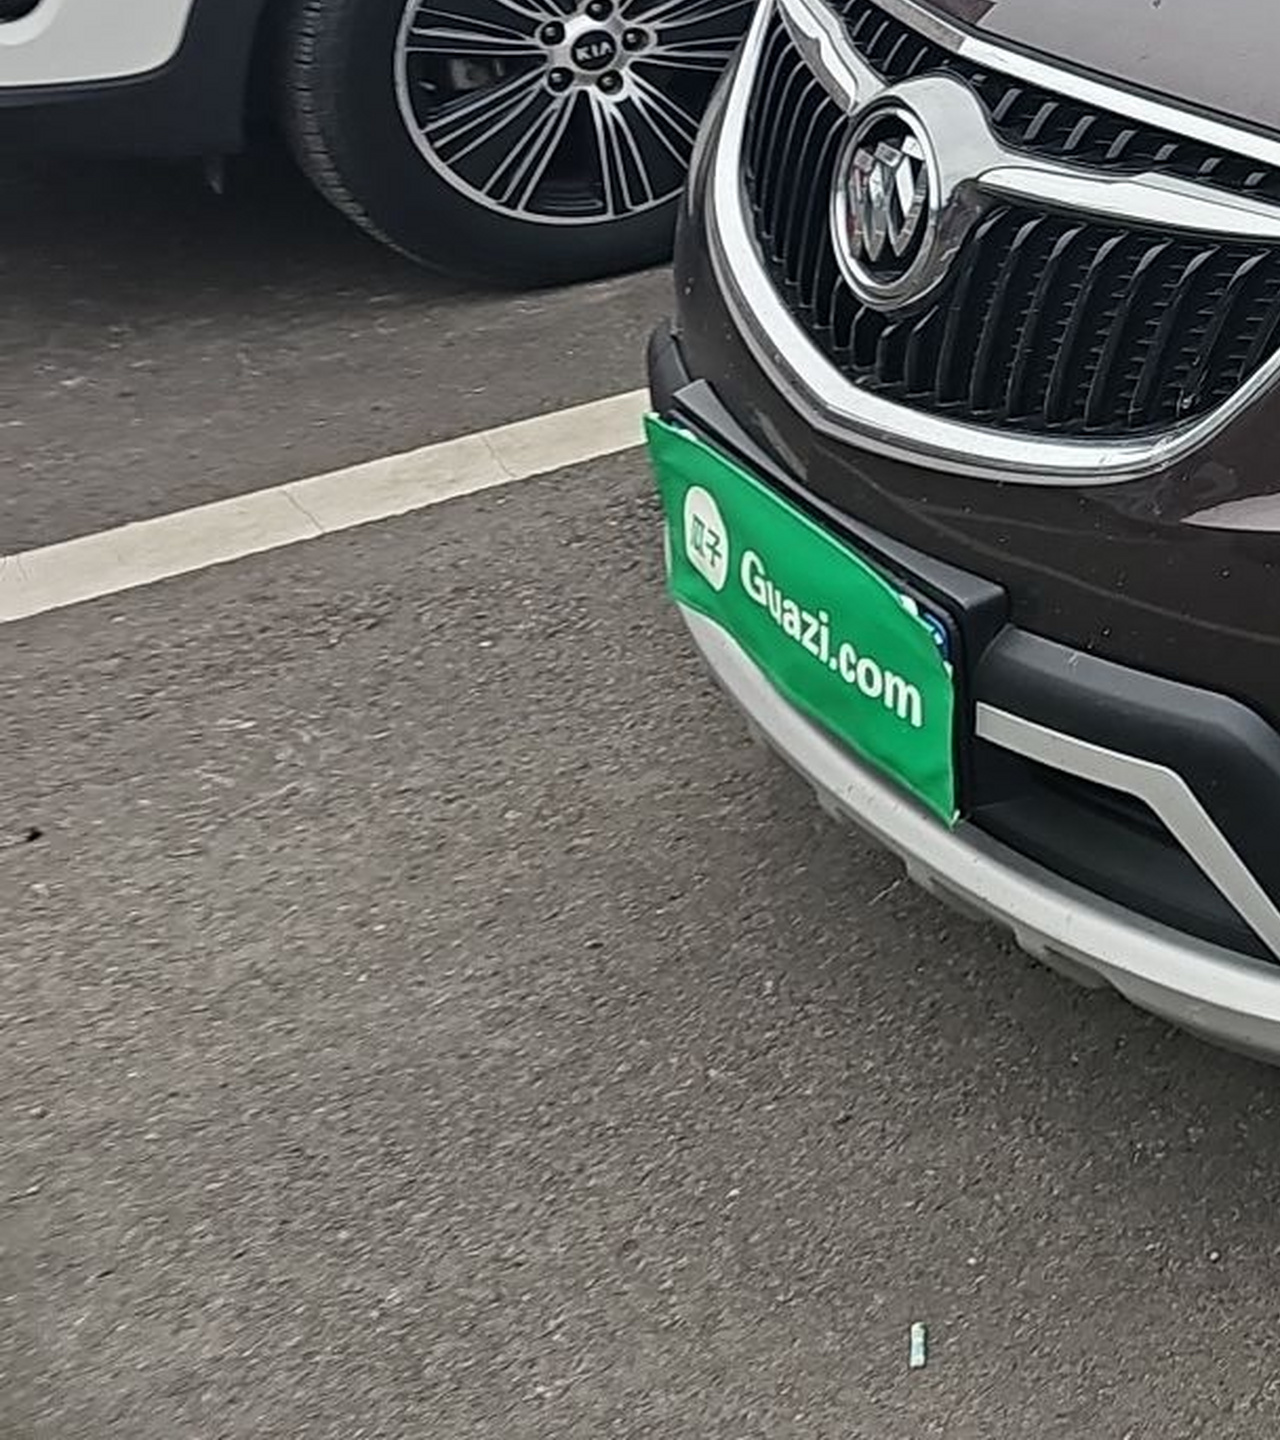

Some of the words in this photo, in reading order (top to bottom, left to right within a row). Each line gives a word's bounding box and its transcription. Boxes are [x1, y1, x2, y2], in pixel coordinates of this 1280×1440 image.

[575, 41, 612, 60] KIA
[691, 513, 722, 567] 瓜子
[741, 550, 922, 727] Guazi.com
